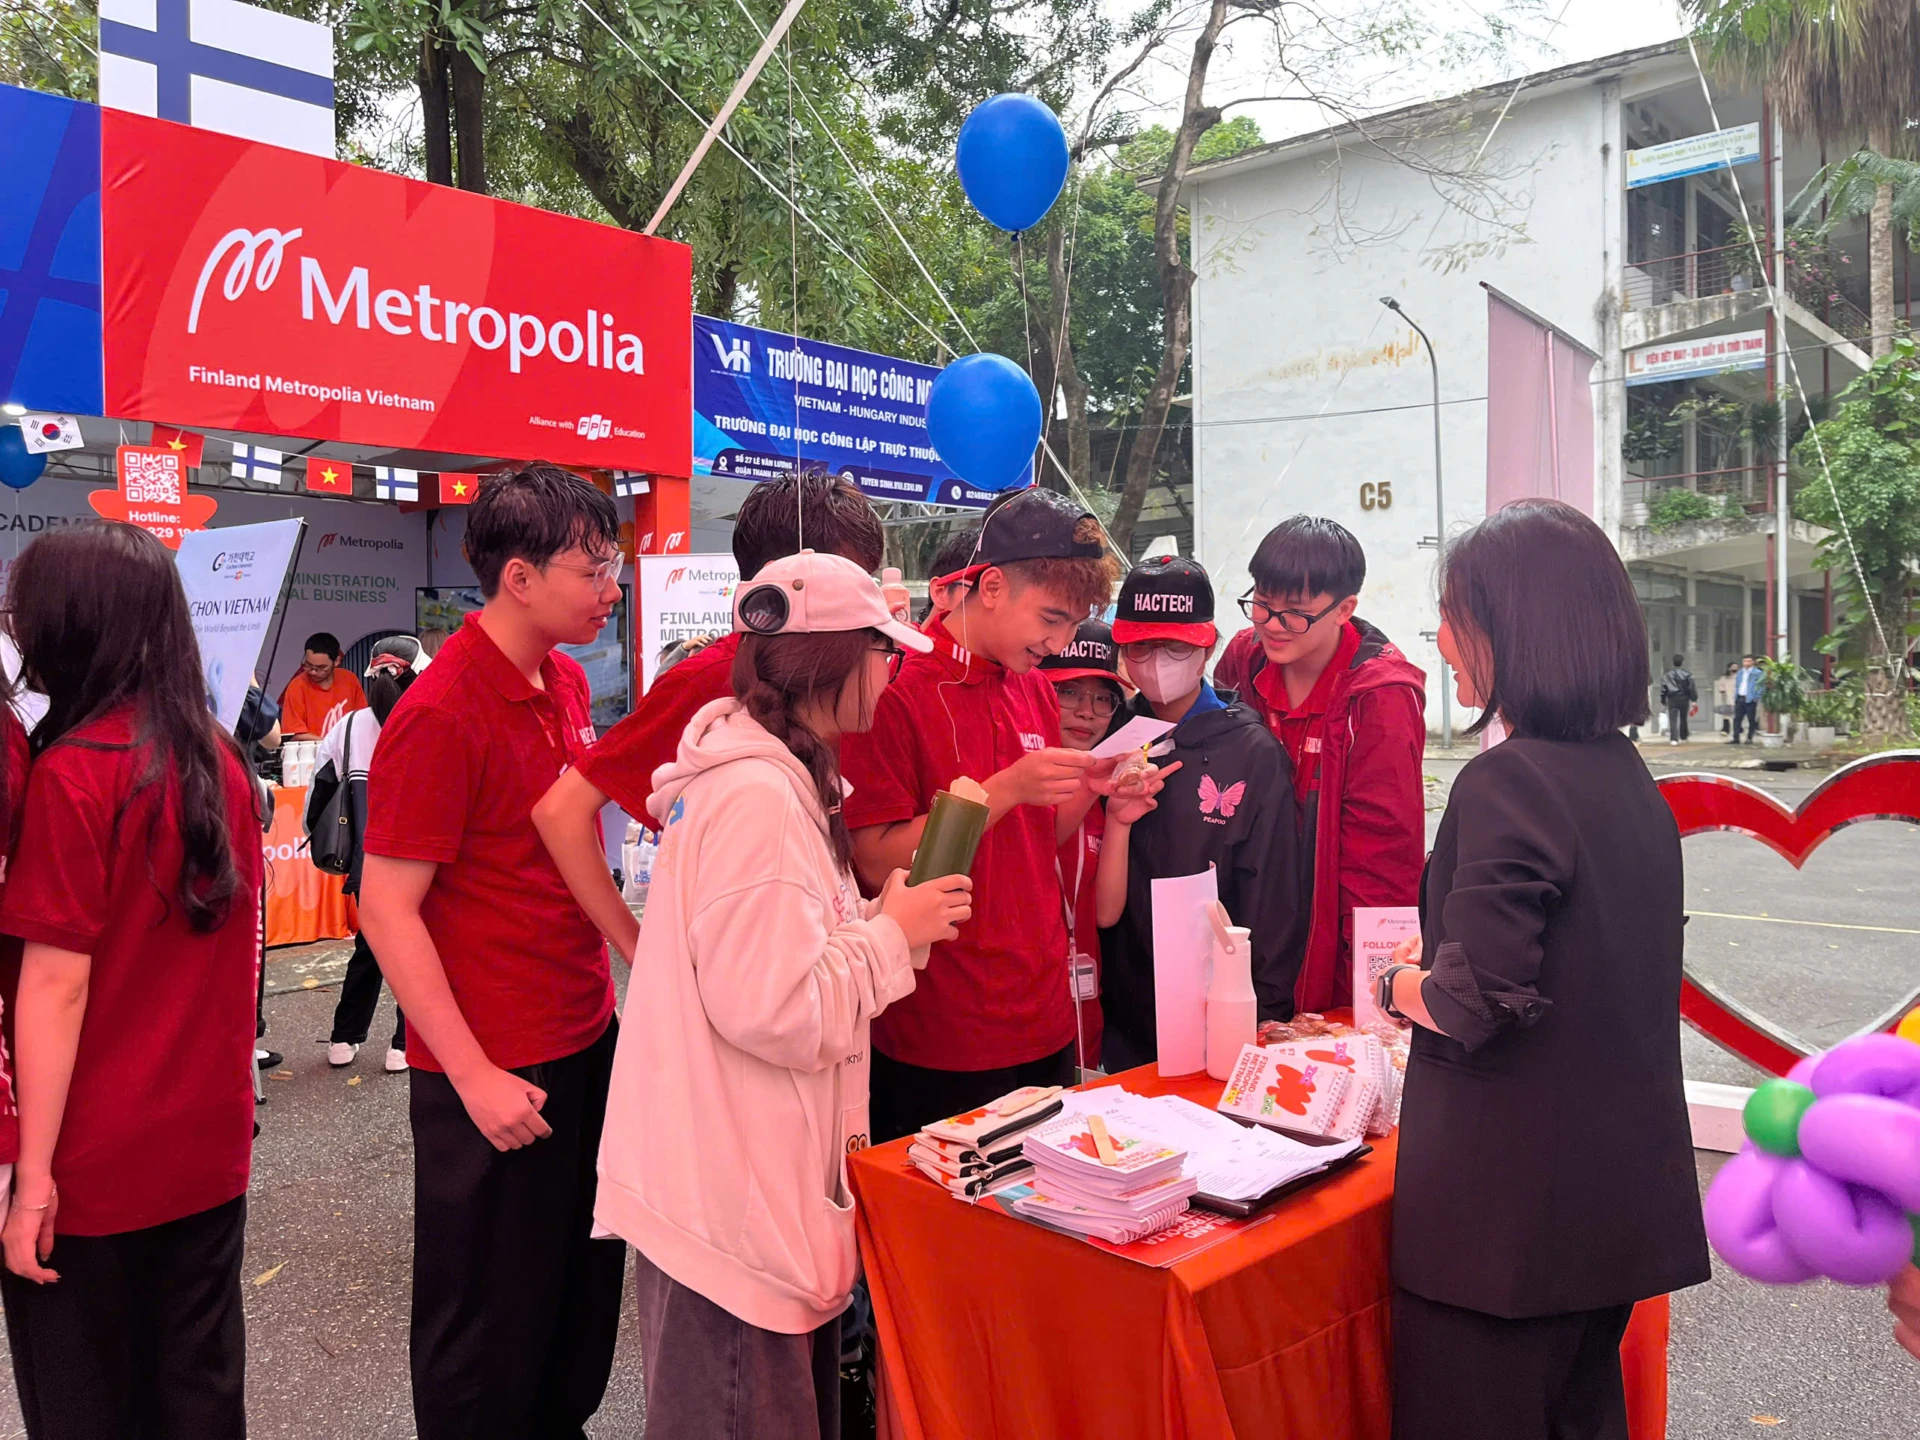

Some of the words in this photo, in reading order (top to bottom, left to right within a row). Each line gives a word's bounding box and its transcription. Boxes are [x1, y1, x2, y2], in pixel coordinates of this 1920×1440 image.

[300, 256, 645, 375] Metropolia
[189, 365, 261, 390] Finland
[265, 375, 361, 404] Metropolia
[365, 389, 435, 412] Vietnam
[767, 346, 823, 386] TRƯỜNG
[825, 359, 848, 396] ĐẠI
[851, 365, 877, 401] HỌC
[880, 367, 914, 404] CÔNG
[794, 395, 841, 414] VIETNAM
[849, 405, 897, 424] HUNGARY
[529, 416, 557, 428] Alliance
[558, 418, 574, 430] with
[577, 414, 612, 440] FPT
[614, 427, 645, 439] Education
[714, 415, 766, 436] TRƯỜNG
[769, 424, 791, 441] ĐẠI
[794, 427, 818, 445] HỌC
[821, 431, 853, 448] CÔNG
[856, 436, 877, 454] LẬP
[879, 441, 907, 458] TRỰC
[1360, 481, 1392, 511] C5
[128, 510, 181, 523] Hotline:
[340, 535, 404, 551] Metropolia
[225, 596, 271, 615] VIETNAM
[314, 589, 387, 603] BUSINESS
[1134, 593, 1193, 613] HACTECH
[263, 836, 312, 870] poli
[1232, 1054, 1260, 1107] METROPOLIA
[1250, 1055, 1268, 1093] FINLAND
